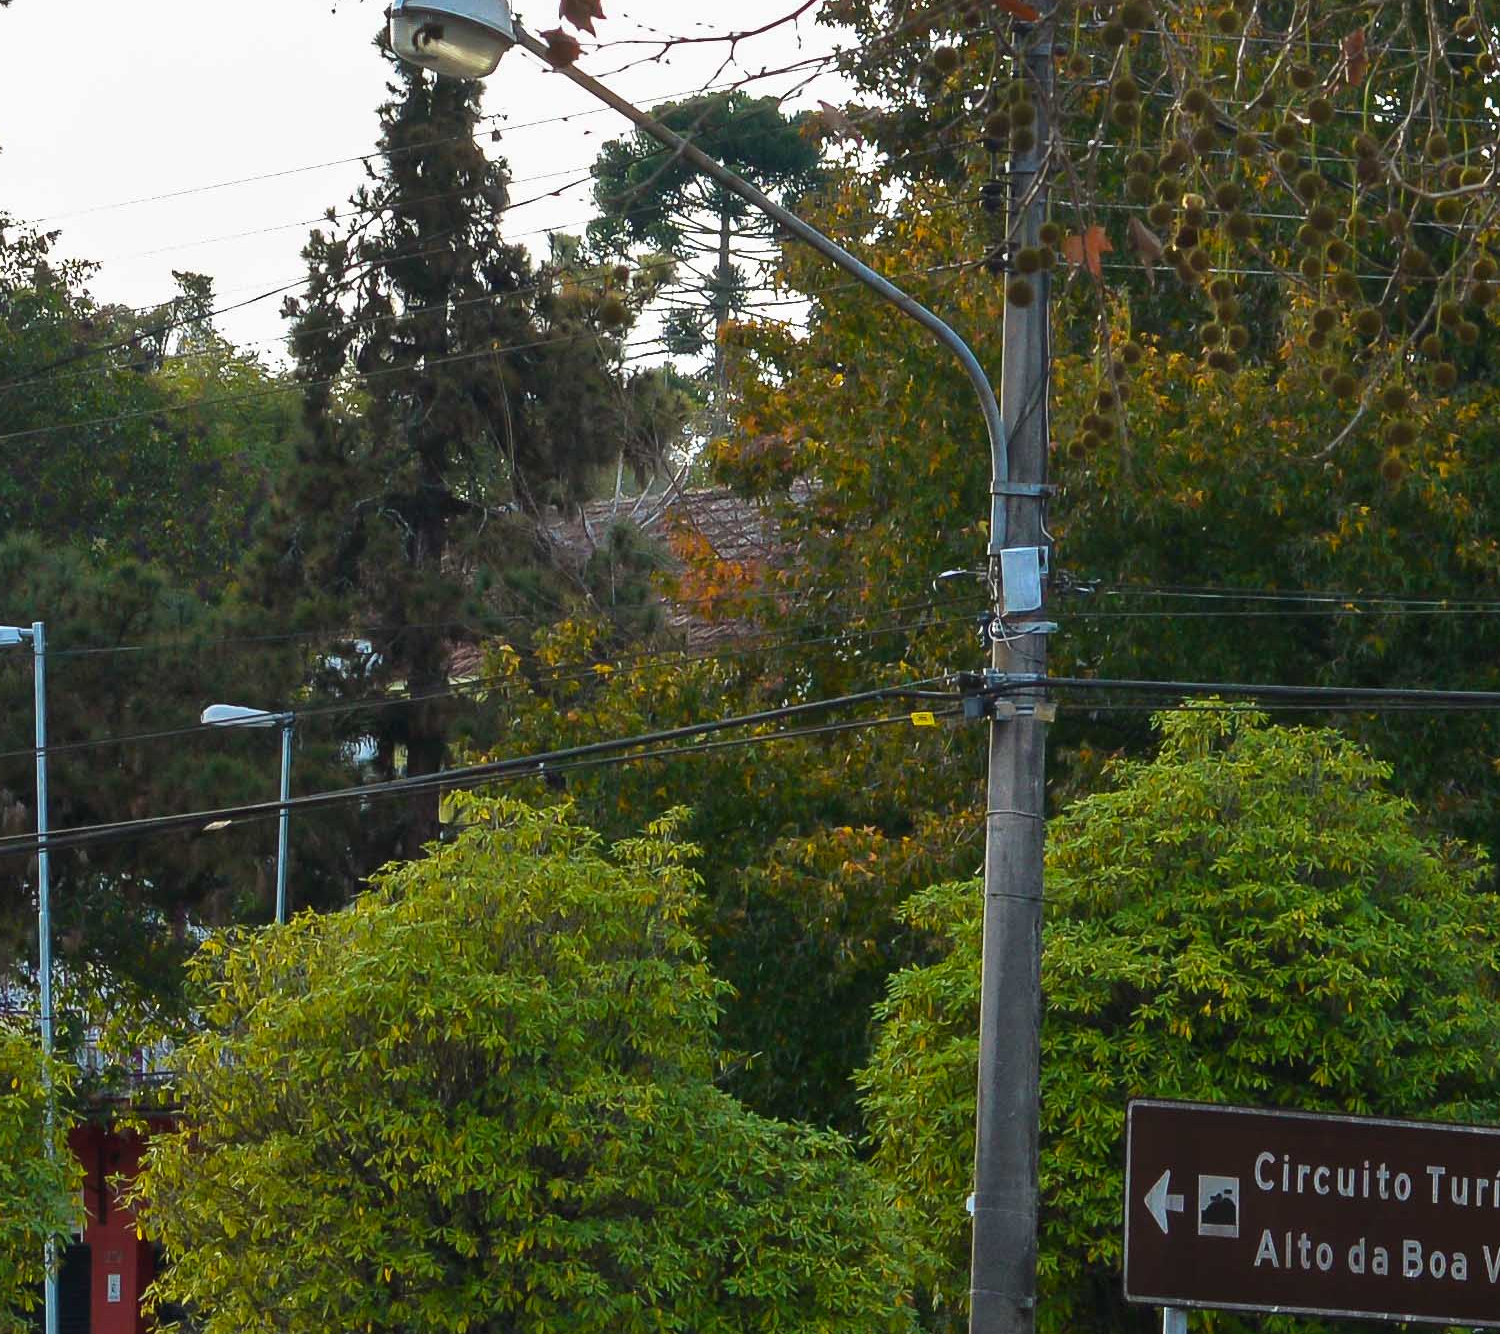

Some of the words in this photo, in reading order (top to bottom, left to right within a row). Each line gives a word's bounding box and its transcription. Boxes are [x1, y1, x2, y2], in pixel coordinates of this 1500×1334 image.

[1254, 1151, 1412, 1202] Circuito
[1253, 1228, 1334, 1271] Alto
[1348, 1237, 1389, 1276] da
[1403, 1240, 1468, 1281] Boa
